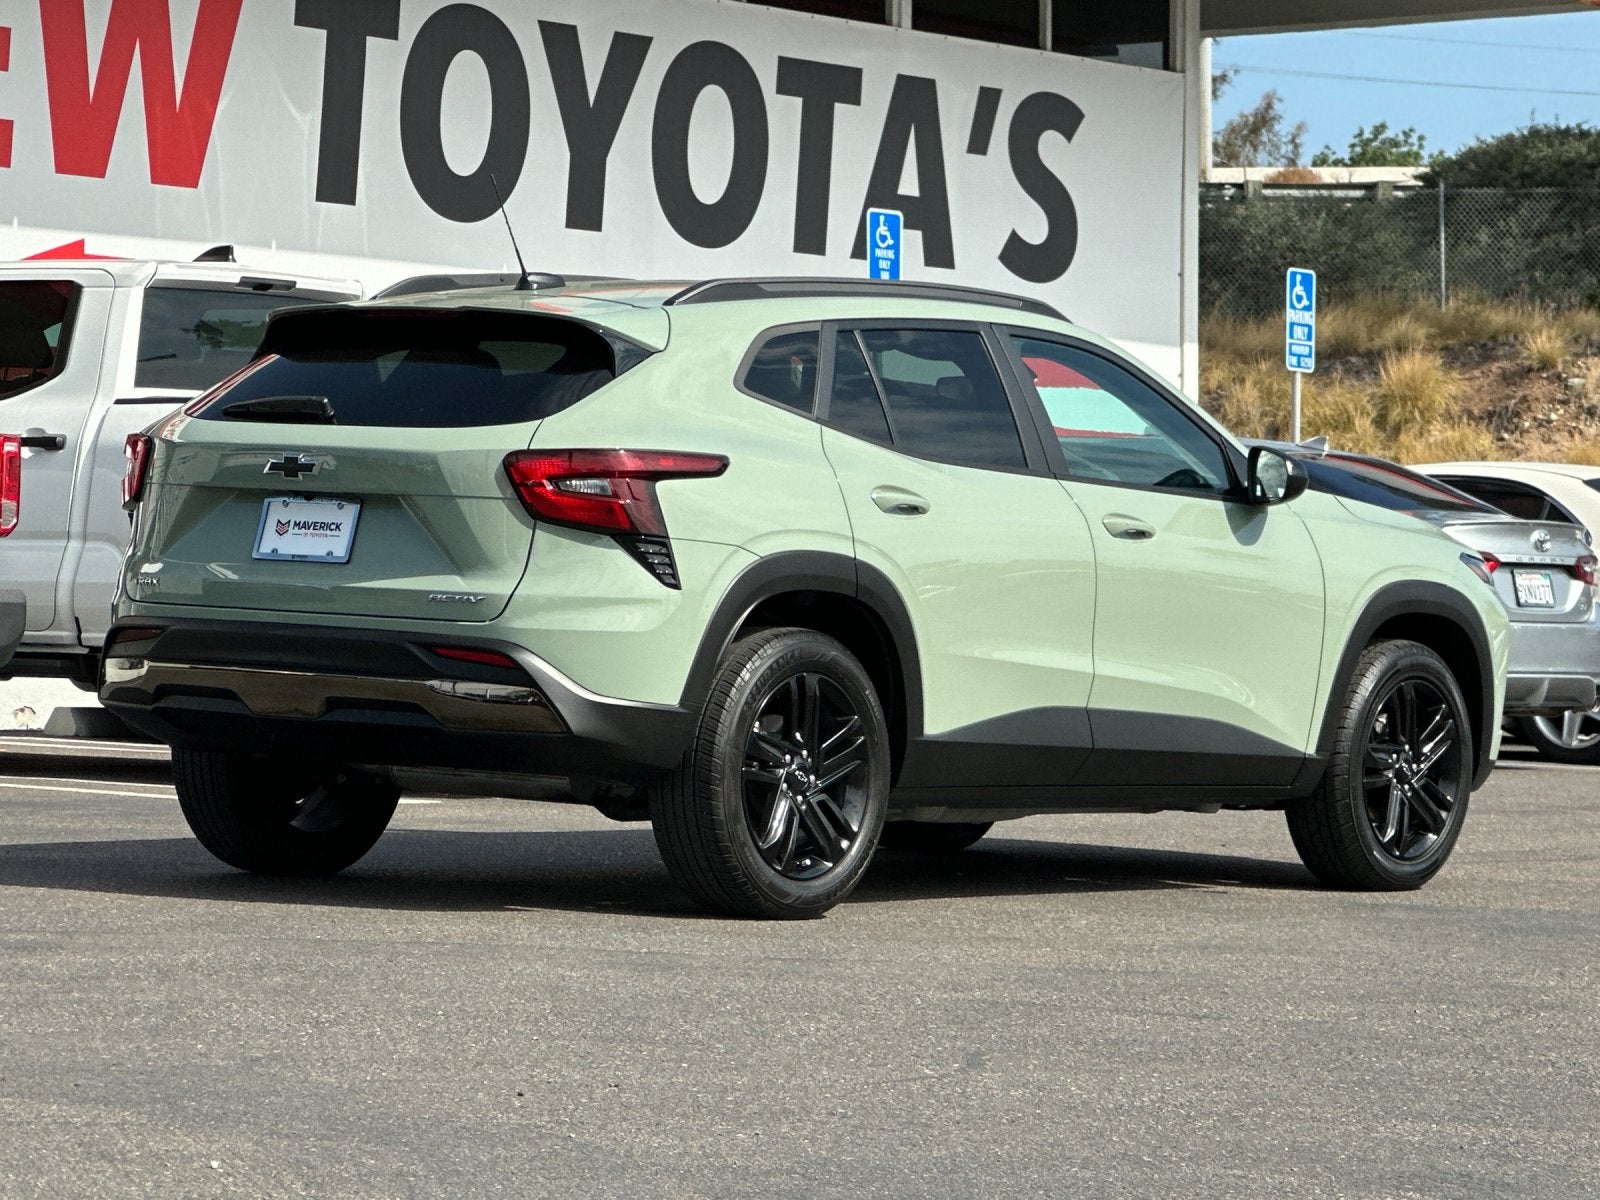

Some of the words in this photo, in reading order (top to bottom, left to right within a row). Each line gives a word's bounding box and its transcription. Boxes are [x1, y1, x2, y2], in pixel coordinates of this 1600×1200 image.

[0, 0, 243, 189] W
[294, 0, 1085, 284] TOYOTA'S
[1289, 309, 1313, 324] PARKING
[1293, 325, 1309, 340] ONLY
[293, 520, 343, 532] MAVERICK
